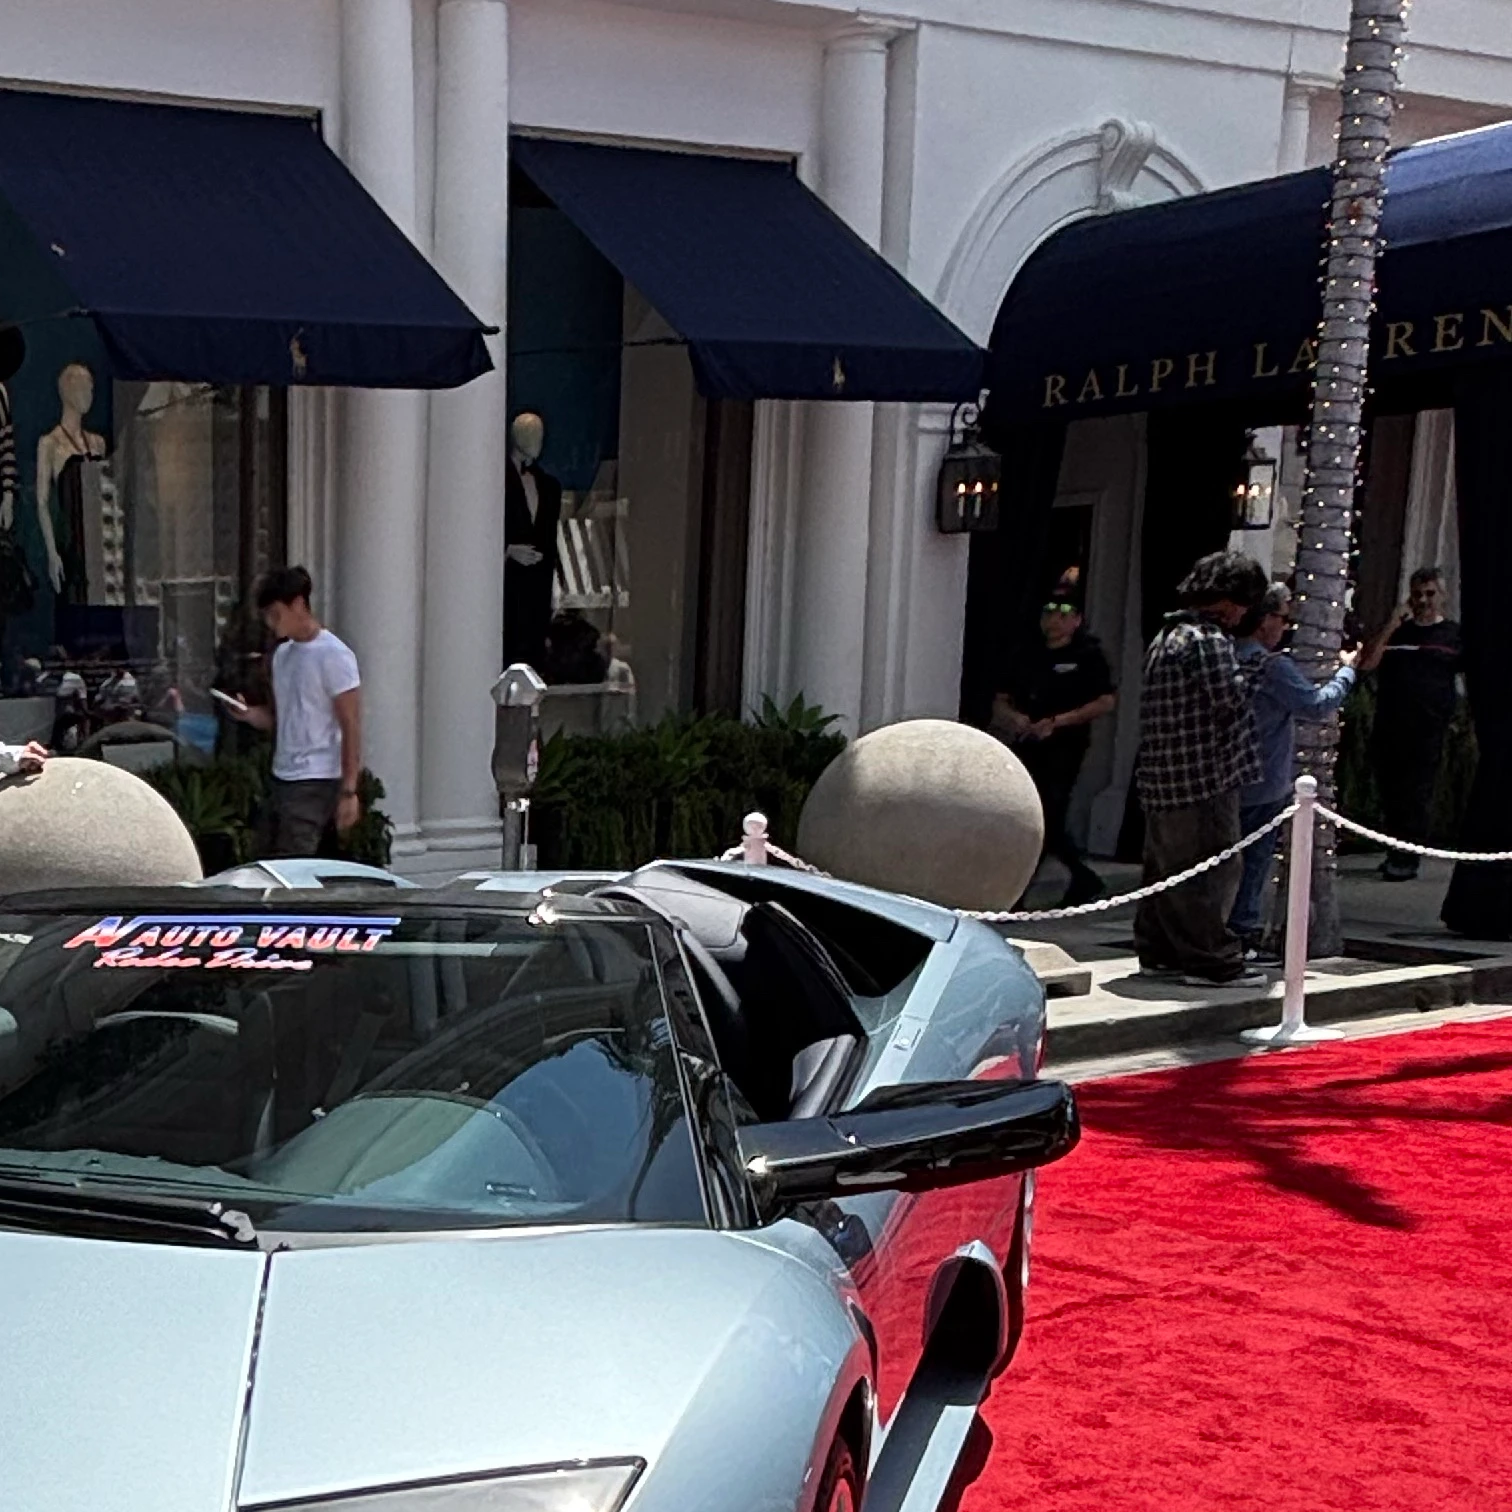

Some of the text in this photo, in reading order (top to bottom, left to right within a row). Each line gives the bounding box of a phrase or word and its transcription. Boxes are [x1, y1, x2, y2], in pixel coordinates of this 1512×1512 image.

[1041, 304, 1512, 407] RALPH LAREN
[130, 925, 244, 948] AUTO
[257, 926, 393, 951] VAULT
